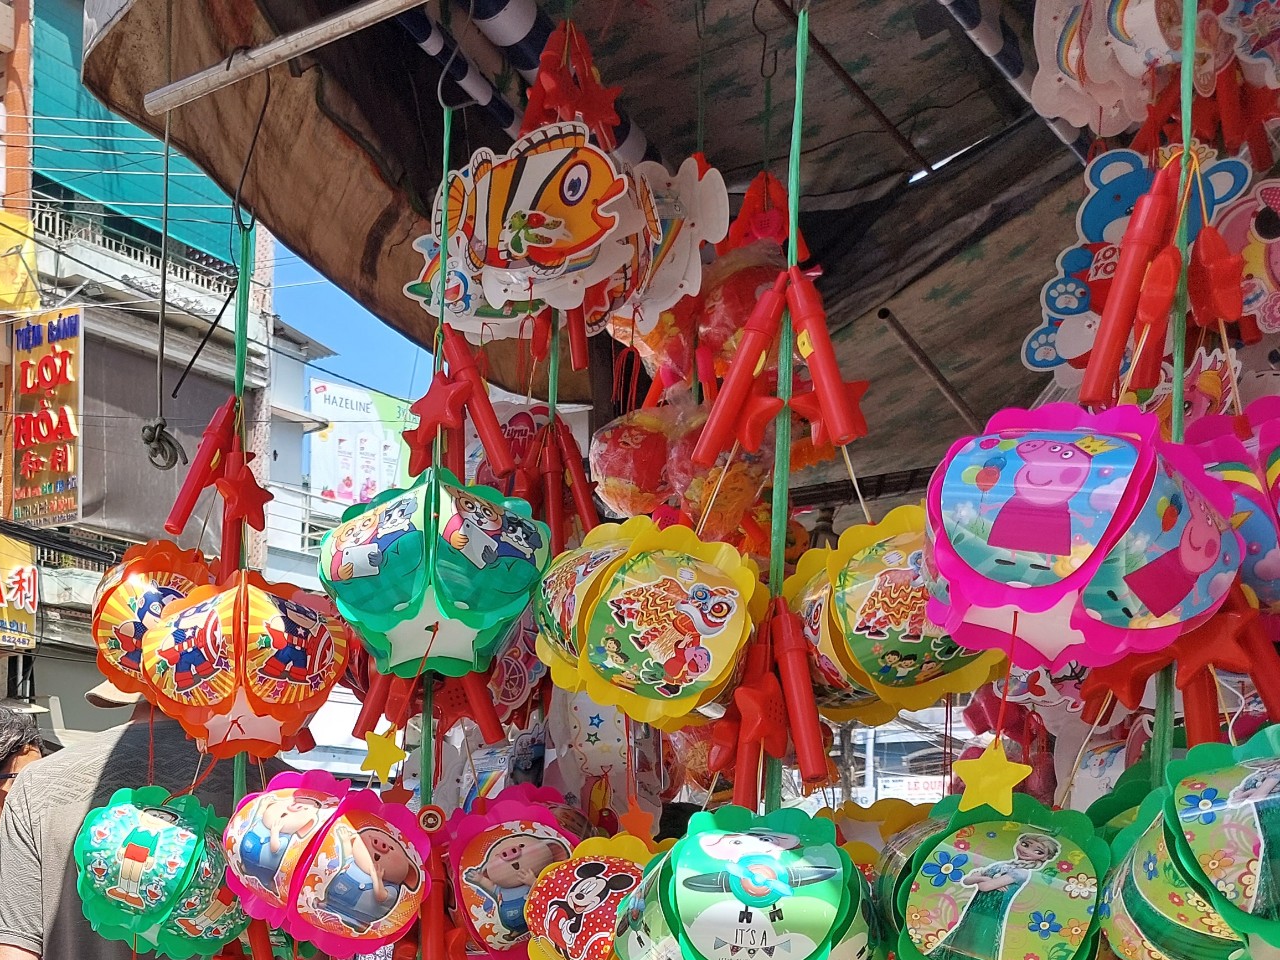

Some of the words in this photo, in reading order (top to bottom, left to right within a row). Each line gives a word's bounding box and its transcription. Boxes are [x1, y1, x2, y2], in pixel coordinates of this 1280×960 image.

[1095, 246, 1120, 265] LO
[1094, 261, 1118, 278] YO
[20, 343, 76, 397] LỢI
[323, 394, 370, 414] HAZELINE
[760, 929, 767, 946] A
